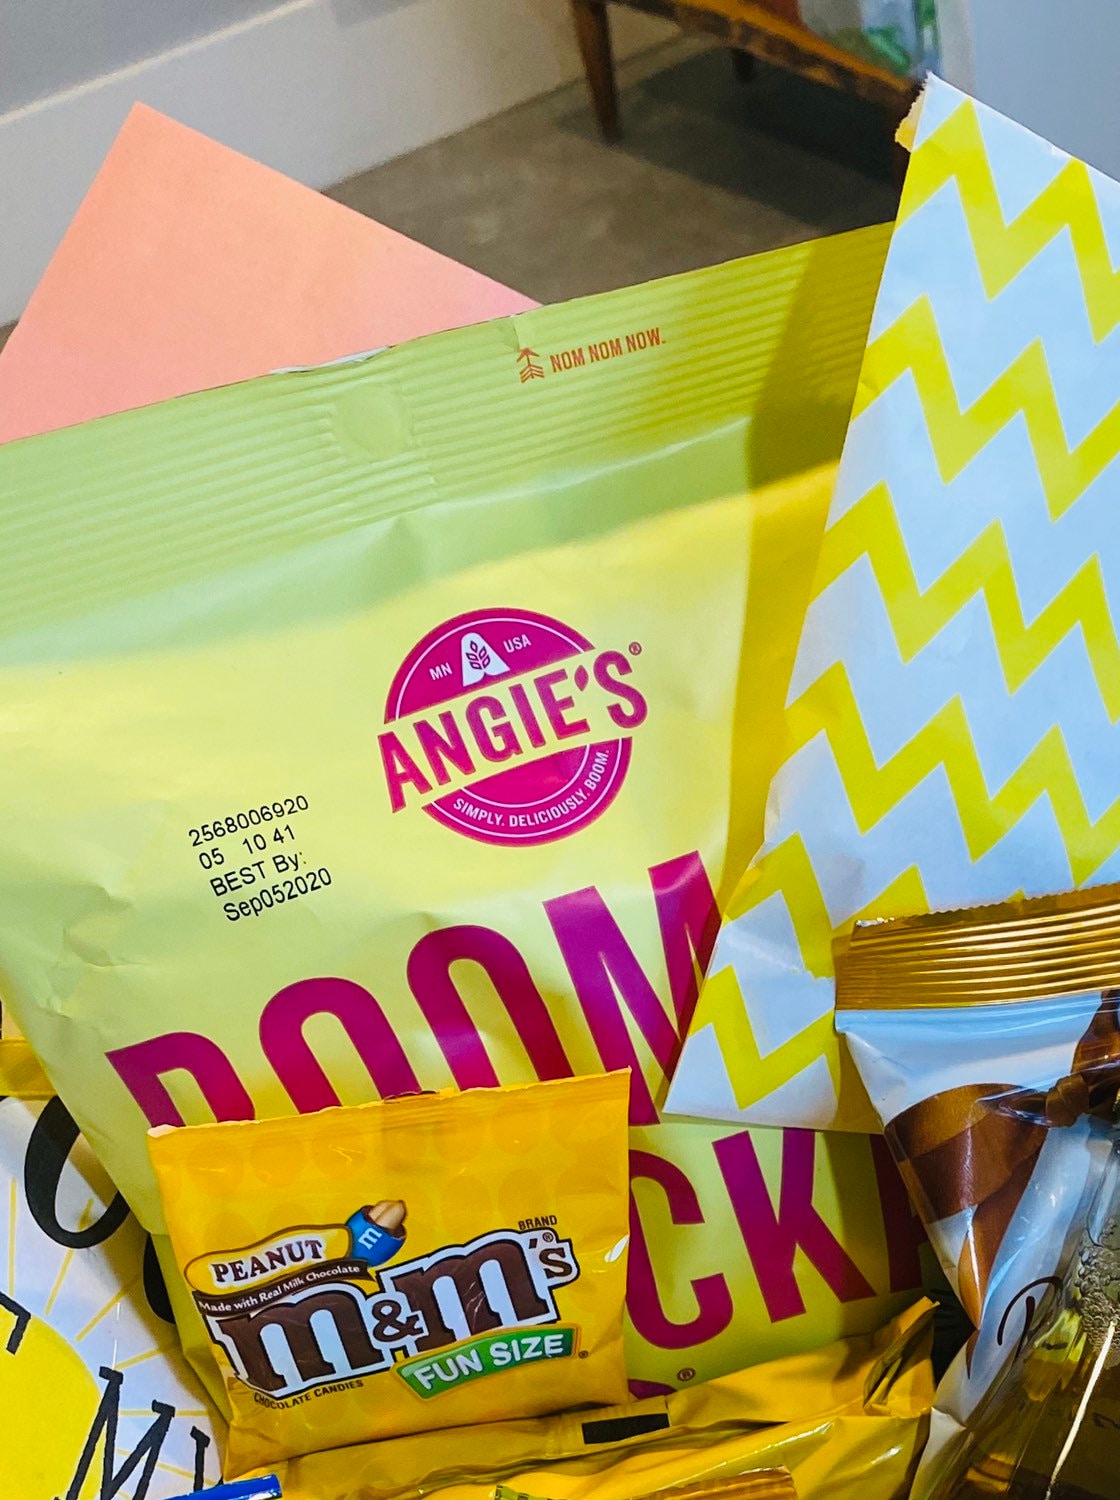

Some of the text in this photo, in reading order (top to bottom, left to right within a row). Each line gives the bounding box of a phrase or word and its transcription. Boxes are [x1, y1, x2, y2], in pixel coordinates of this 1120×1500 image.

[550, 327, 667, 373] NOM NOM NOW.
[429, 634, 532, 681] MN USA
[377, 650, 648, 814] ANGIE'S
[452, 748, 611, 828] SIMPLY. DELICIOUSLY. BOOM.
[188, 795, 309, 847] 2568006920
[198, 824, 295, 870] 05 10 41
[209, 860, 266, 897] BEST
[223, 867, 332, 921] Sep052020
[517, 1214, 559, 1231] BRAND
[213, 1238, 325, 1284] PEANUT
[199, 1263, 361, 1314] Made with Real Milk Chocolate
[412, 1332, 565, 1391] FUN SIZE
[313, 1378, 365, 1399] CANDIES
